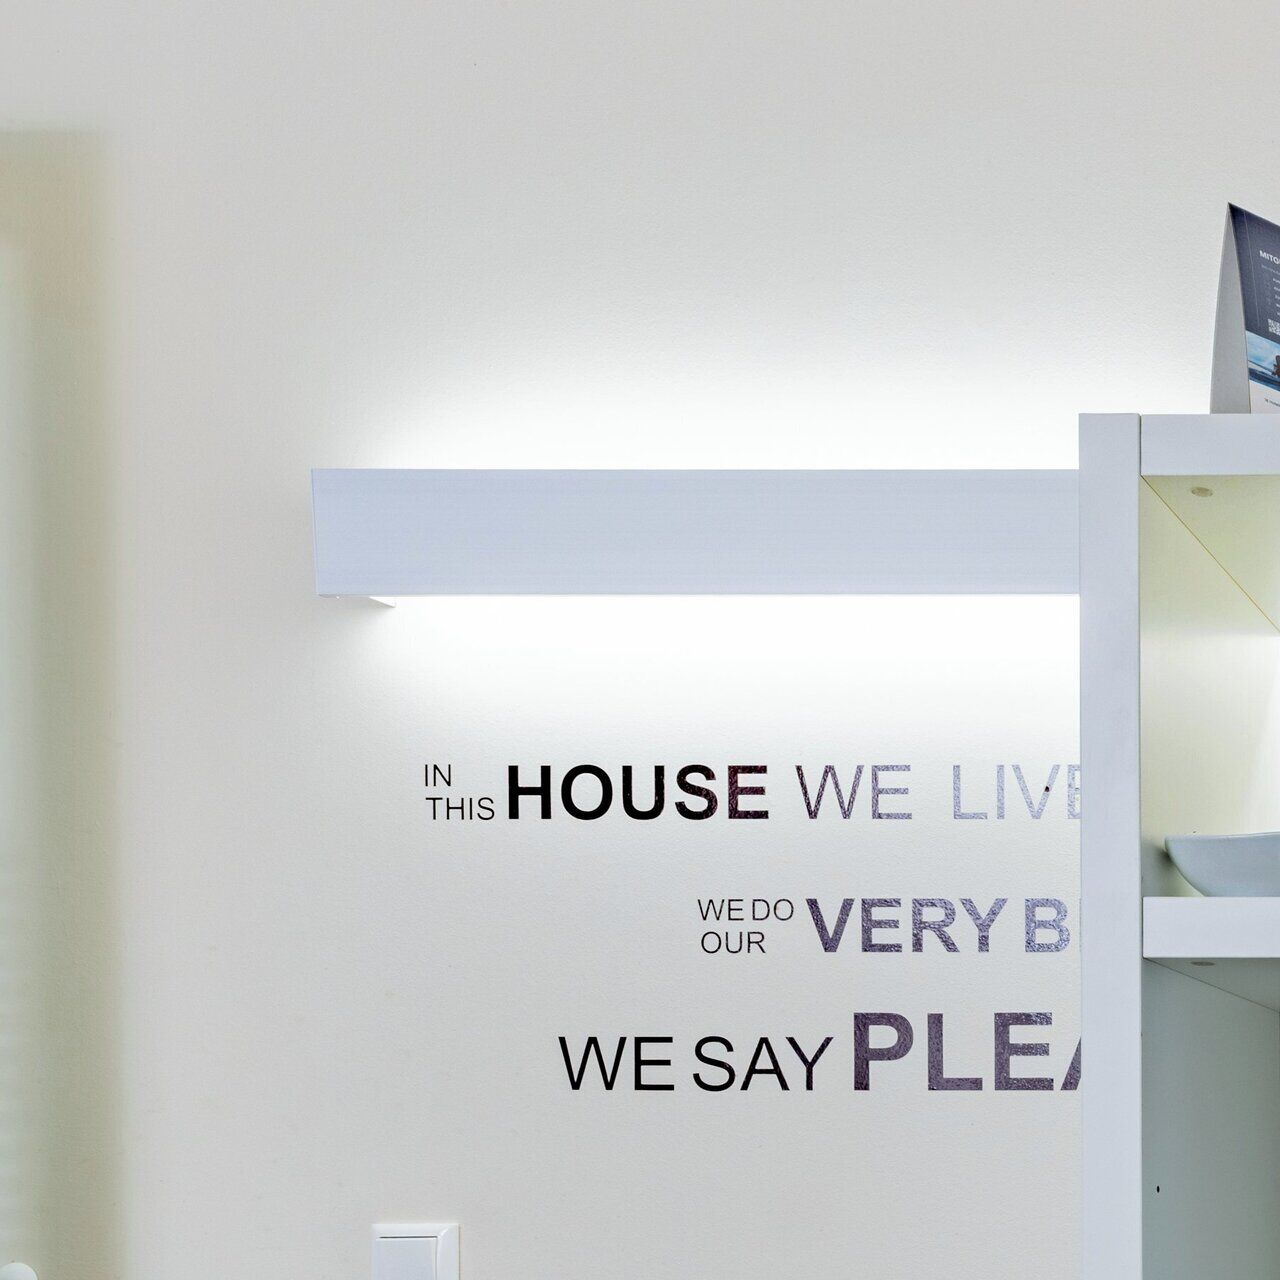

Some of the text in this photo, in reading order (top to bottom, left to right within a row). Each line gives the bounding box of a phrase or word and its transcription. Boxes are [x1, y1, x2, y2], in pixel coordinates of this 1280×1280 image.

[424, 764, 452, 787] IN
[425, 797, 495, 820] THIS
[508, 764, 769, 820] HOUSE
[795, 765, 912, 819] WE
[697, 898, 795, 921] WE DO
[700, 898, 1081, 954] OUR VERY B
[558, 1036, 675, 1091] WE
[692, 1035, 834, 1092] SAY
